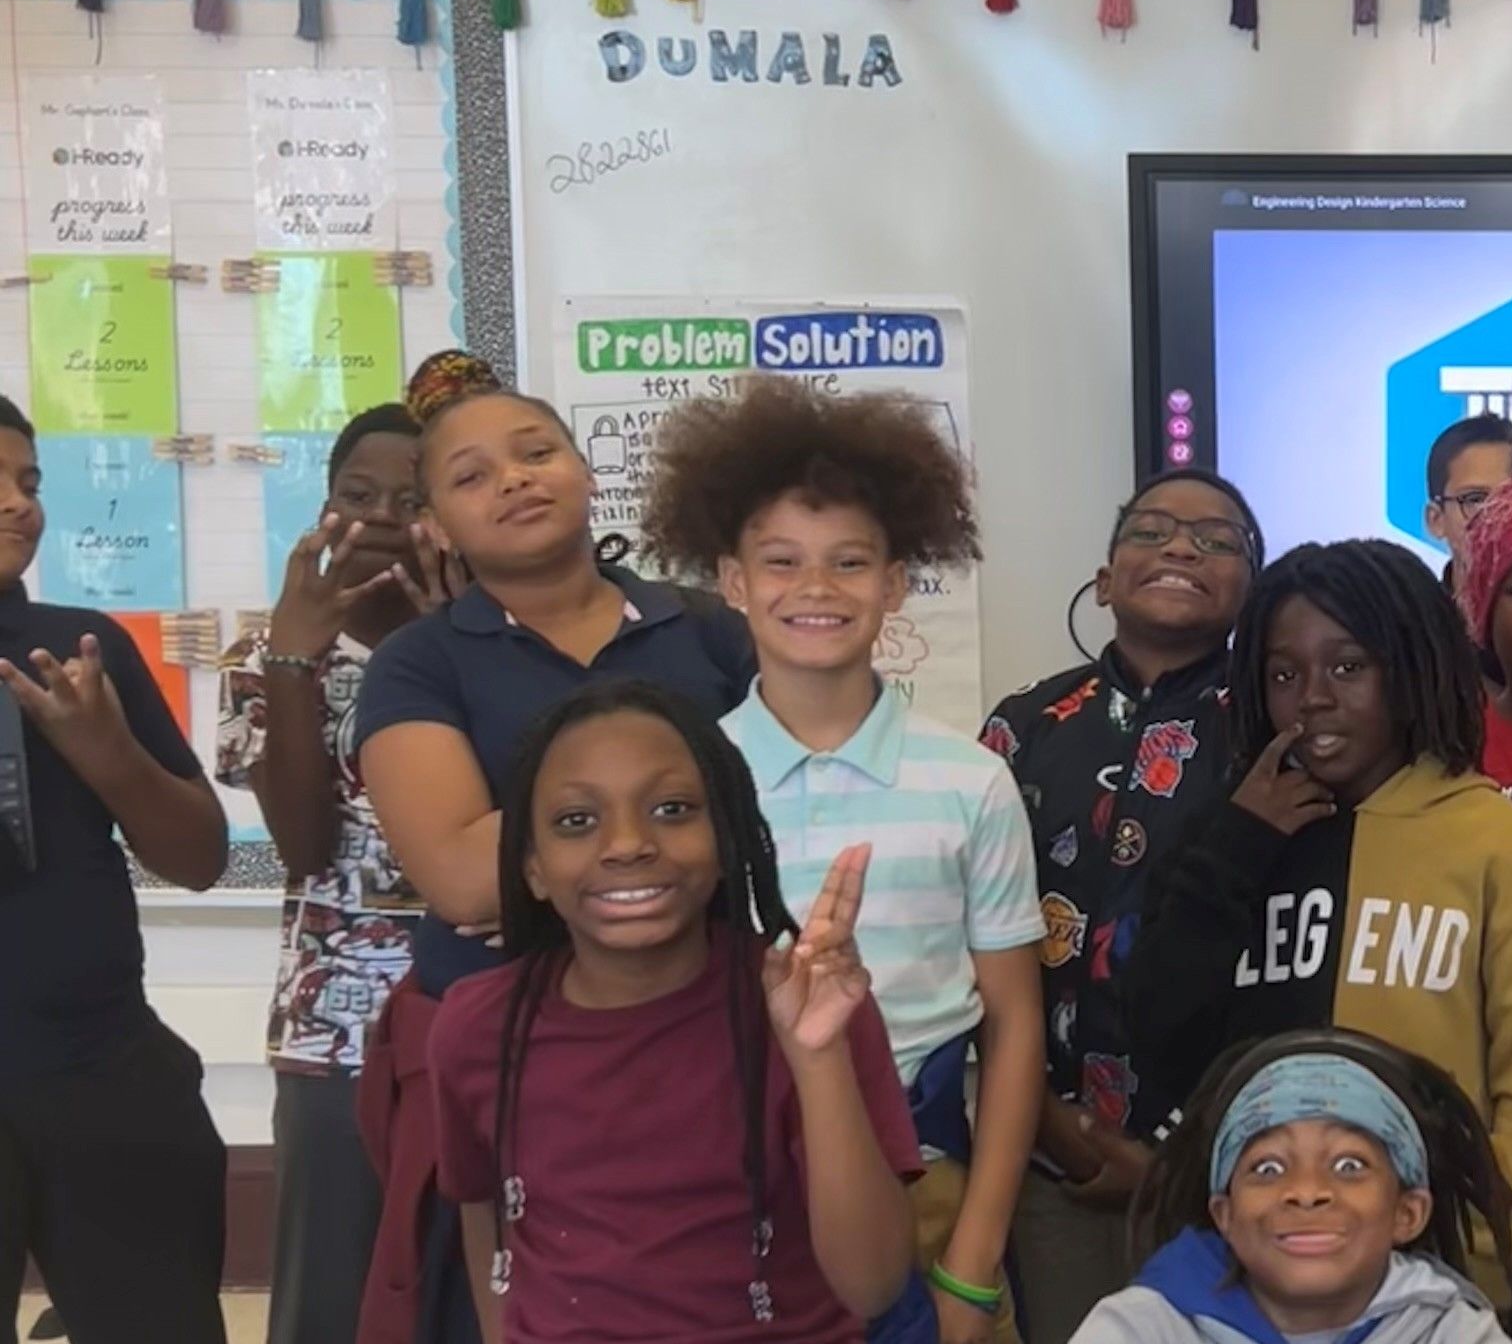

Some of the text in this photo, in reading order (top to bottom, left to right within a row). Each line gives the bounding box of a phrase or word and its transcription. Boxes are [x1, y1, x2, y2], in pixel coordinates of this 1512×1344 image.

[597, 28, 903, 88] DUMALA
[50, 199, 146, 223] progress
[57, 220, 149, 242] this week
[99, 321, 117, 344] 2
[325, 318, 343, 340] 2
[587, 314, 935, 368] Problem Solution
[64, 349, 149, 372] Lessons
[641, 375, 691, 400] text
[110, 499, 117, 521] 1
[591, 504, 640, 523] Fixin
[76, 526, 150, 549] Lesson
[326, 982, 372, 1014] 62
